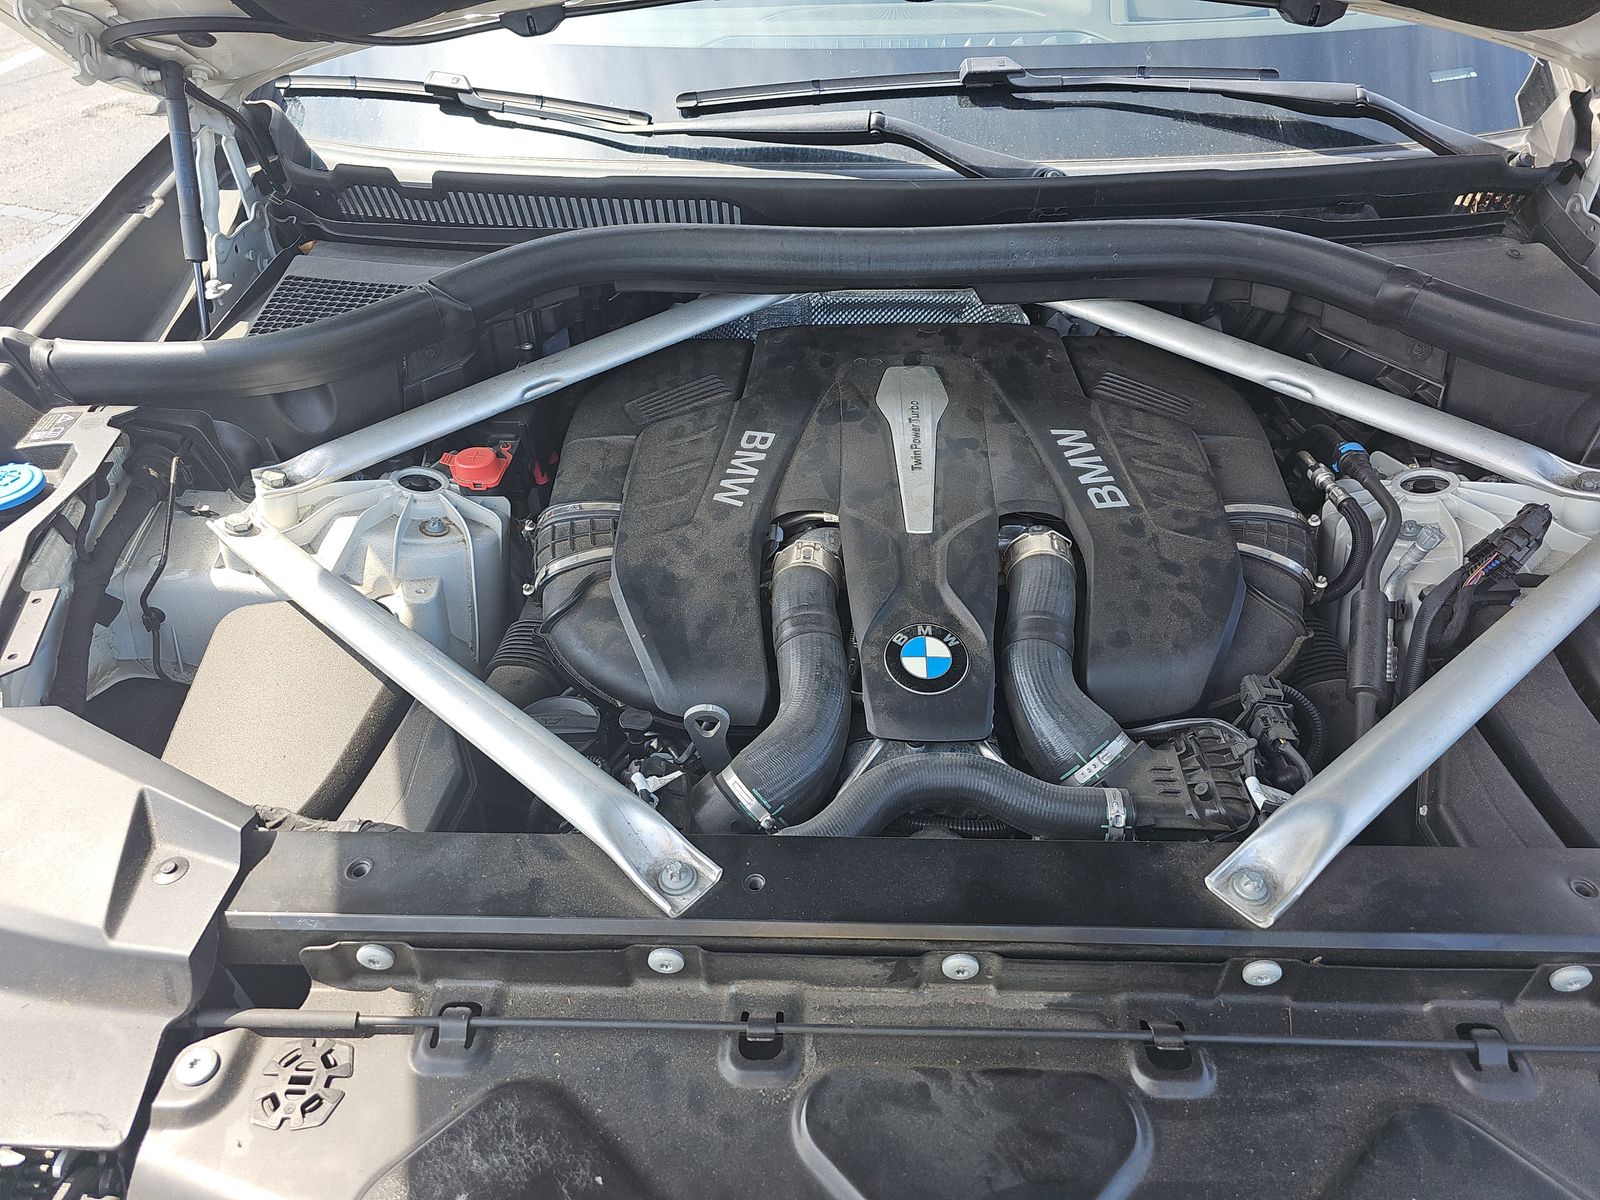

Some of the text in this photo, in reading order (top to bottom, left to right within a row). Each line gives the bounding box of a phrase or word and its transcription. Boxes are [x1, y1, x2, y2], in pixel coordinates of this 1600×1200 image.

[713, 430, 776, 507] BMW
[1049, 429, 1130, 509] BMW
[892, 625, 960, 647] BMW
